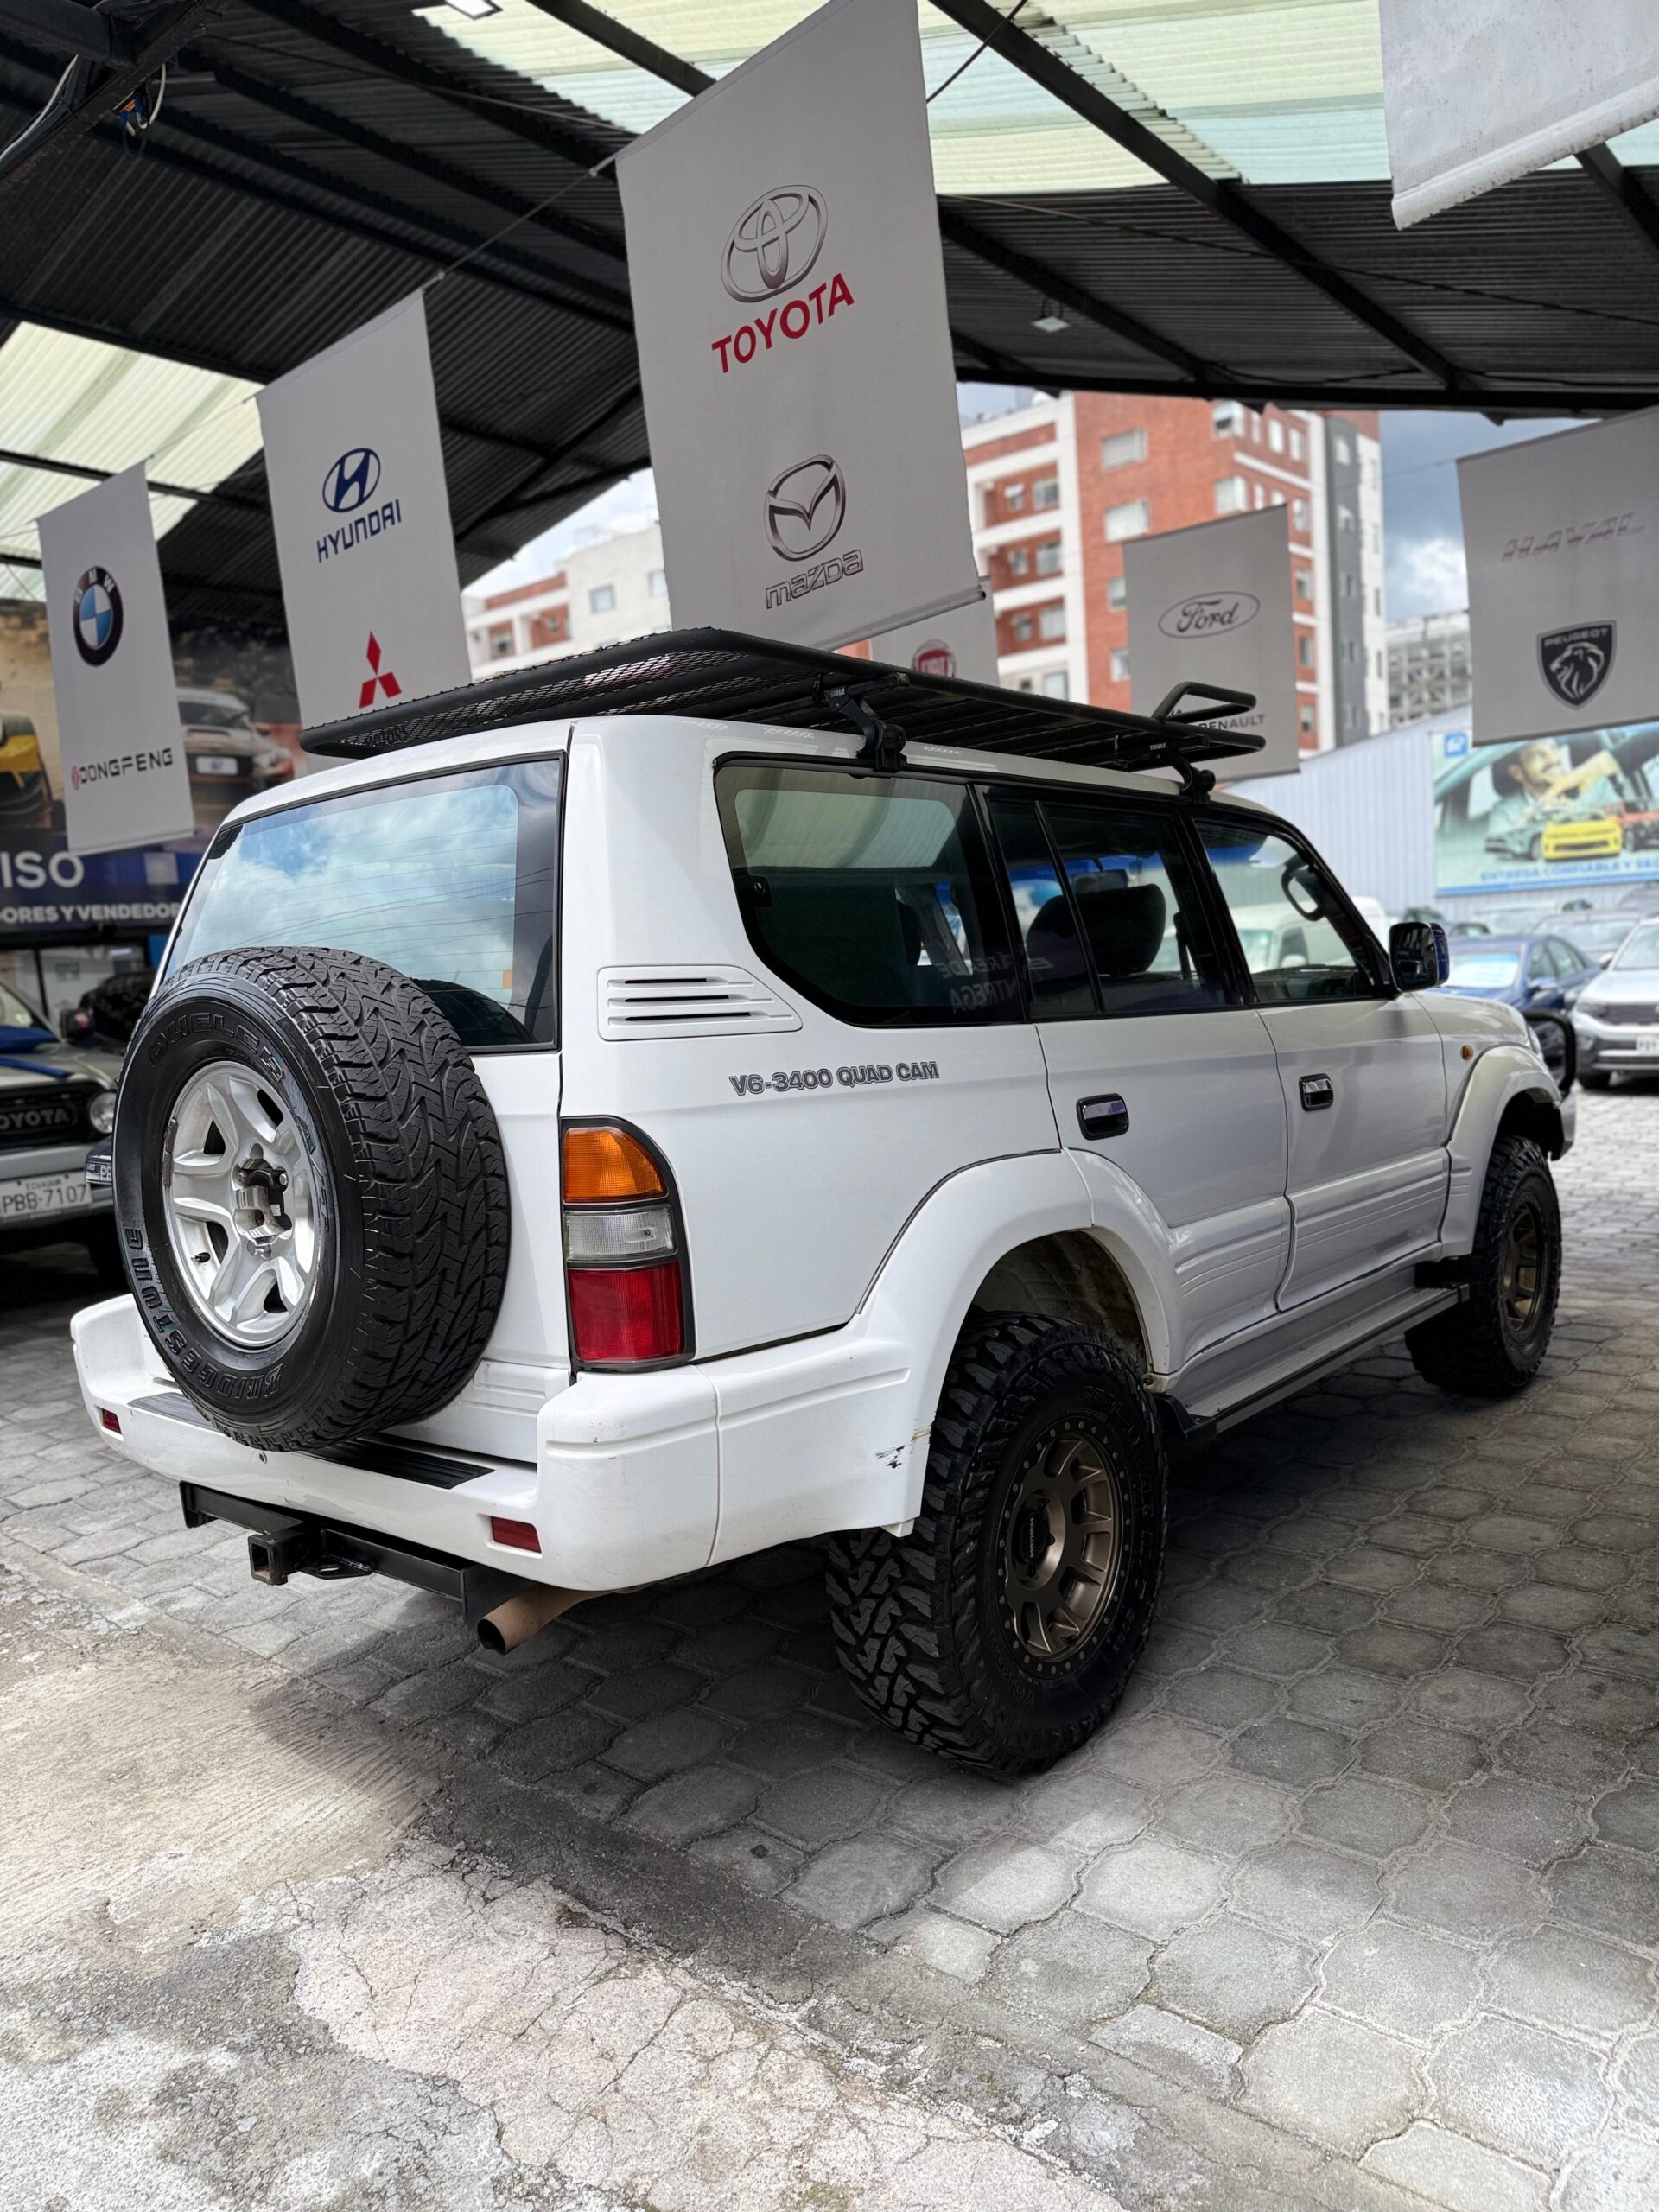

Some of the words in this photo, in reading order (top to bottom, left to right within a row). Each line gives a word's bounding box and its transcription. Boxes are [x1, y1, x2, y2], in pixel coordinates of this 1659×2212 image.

[711, 272, 855, 374] TOYOTA
[316, 499, 402, 563] HYUNDAI
[74, 567, 115, 604] BMW
[766, 549, 864, 610] mazda
[1176, 598, 1240, 633] Ford
[1544, 627, 1609, 648] PEUGEOT
[80, 747, 173, 784] DONGFENG
[0, 849, 85, 889] ISO
[0, 905, 60, 924] ORES
[60, 904, 76, 923] Y
[728, 1068, 834, 1096] V6-3400
[836, 1064, 893, 1089] QUAD
[895, 1061, 940, 1081] CAM
[2, 1184, 87, 1214] PBB-7107
[25, 1178, 62, 1190] ECUADOR
[124, 1227, 285, 1401] BRIDGESTONE
